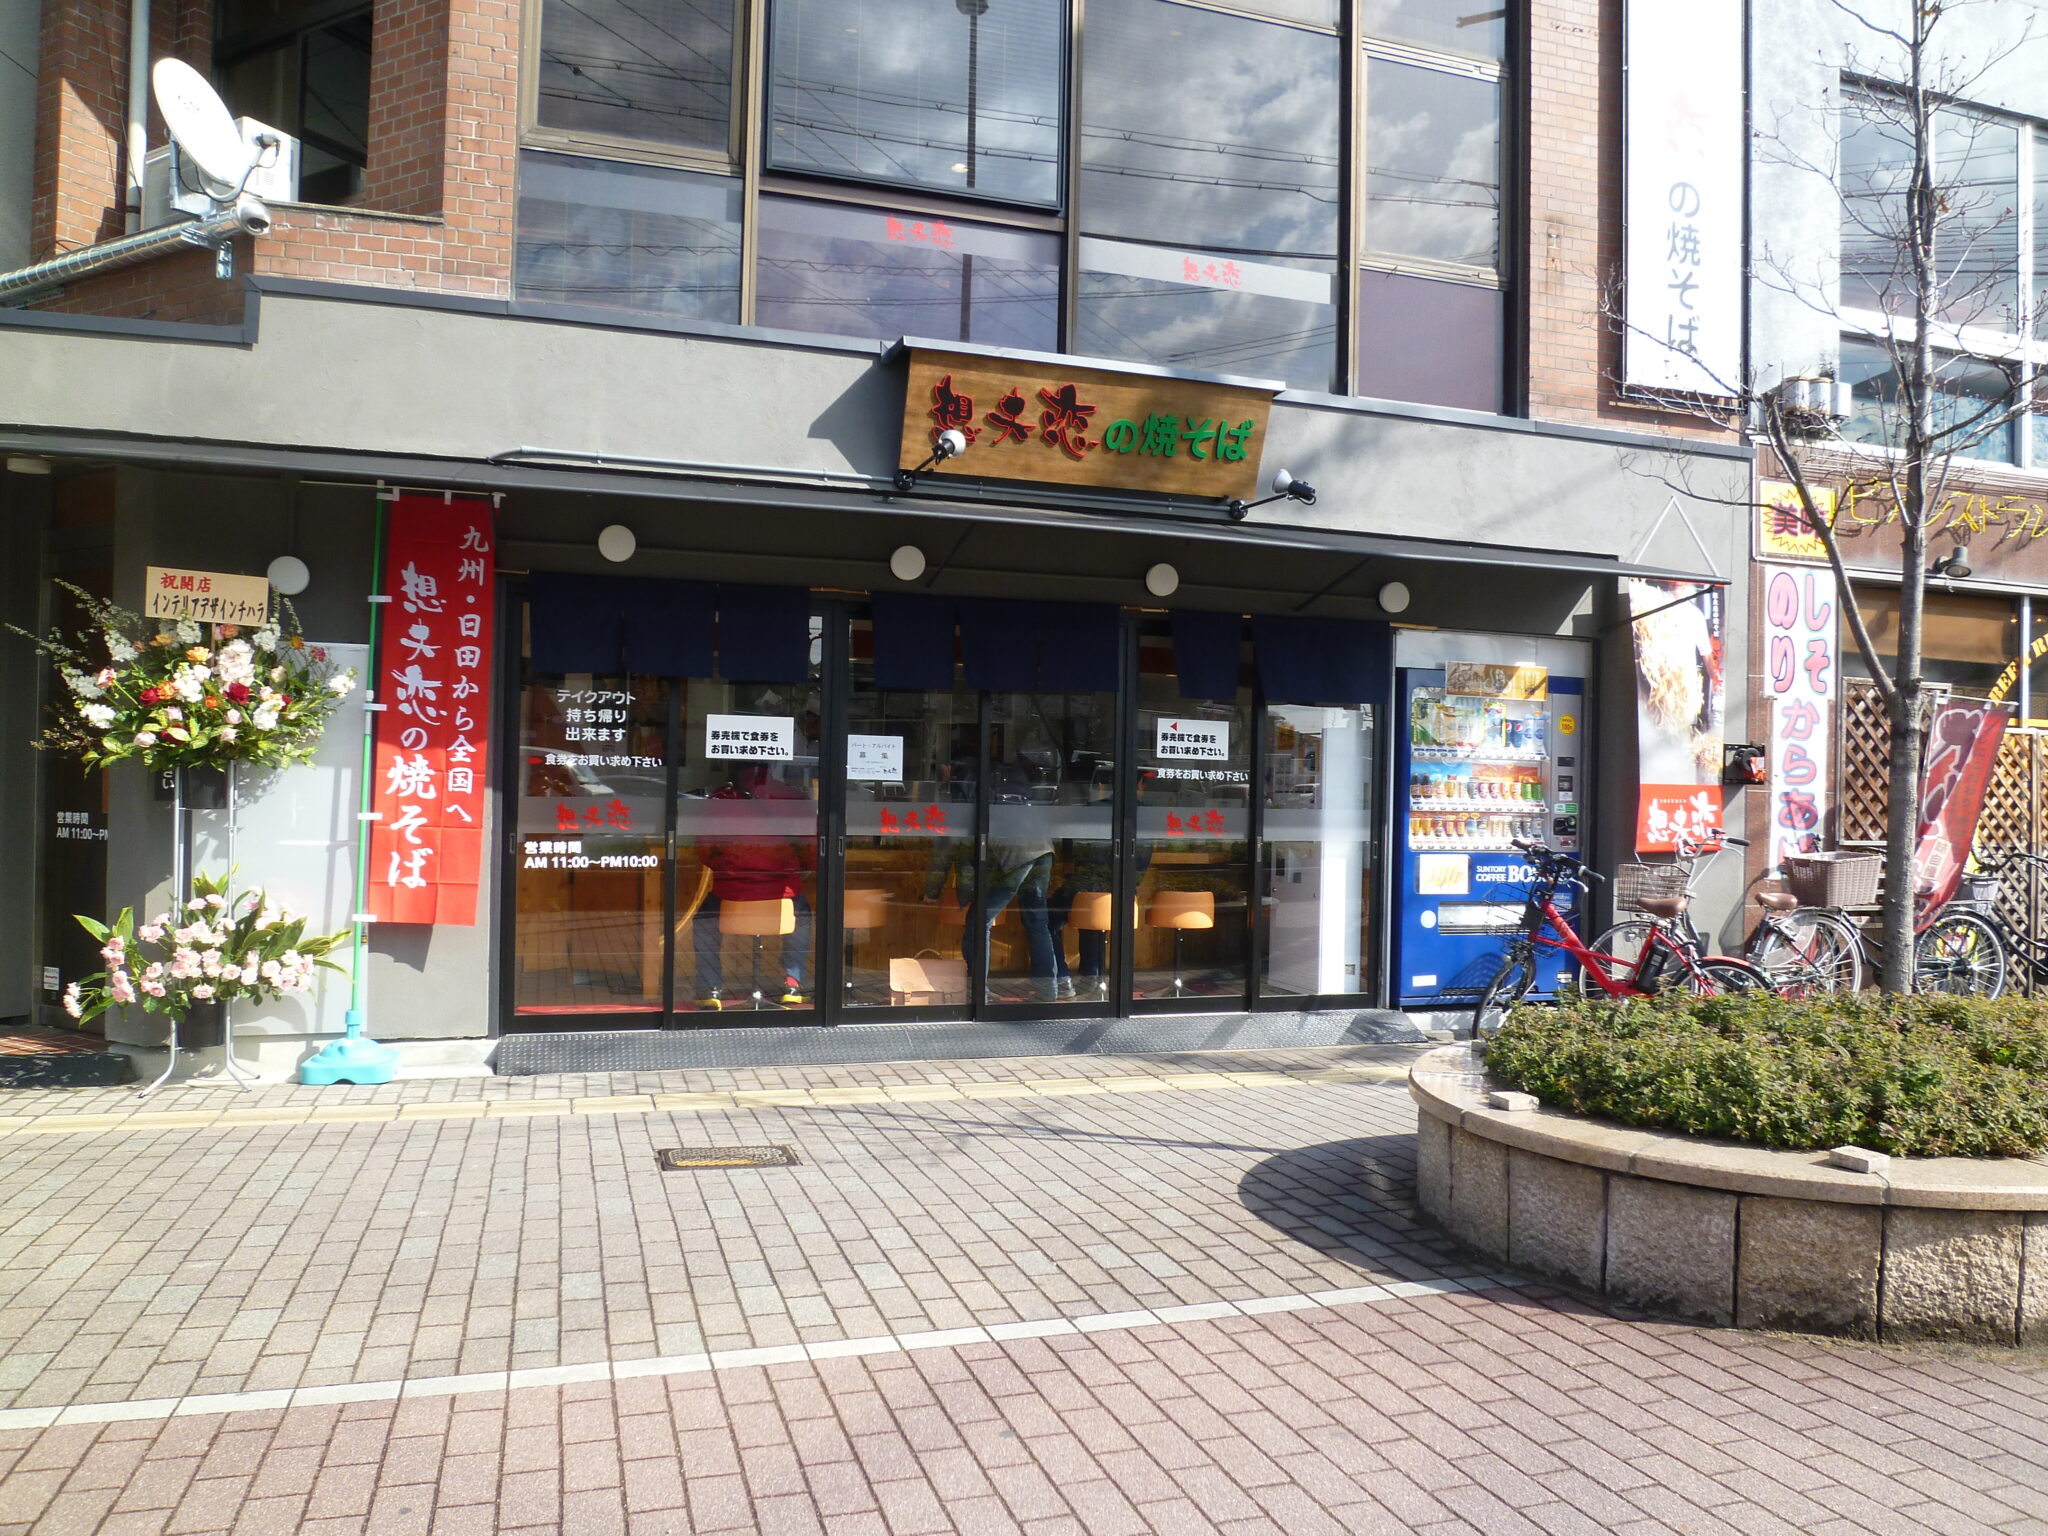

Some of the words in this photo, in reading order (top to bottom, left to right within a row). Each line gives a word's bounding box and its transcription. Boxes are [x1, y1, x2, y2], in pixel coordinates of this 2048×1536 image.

[160, 573, 212, 593] 祝開店
[1767, 572, 1799, 694] のり
[1804, 572, 1831, 694] しそ
[444, 525, 490, 823] 九州・日田から全国へ
[556, 689, 637, 705] テイクアウト
[565, 708, 627, 723] 持ち帰り
[385, 560, 447, 889] 想夫恋の焼そば
[565, 727, 627, 742] 出来ます
[710, 730, 779, 742] 券売機で食券を
[1160, 732, 1217, 744] 券売機で食券を
[710, 744, 789, 756] お買い求め下さい。
[1160, 745, 1225, 757] お買い求め下さい。
[545, 753, 663, 768] 食券をお買い求め下さい
[1157, 768, 1249, 781] 食券をお買い求め下さい
[56, 811, 89, 825] 営業時間
[56, 828, 69, 839] AM
[524, 841, 582, 854] 営業時間
[524, 857, 548, 868] AM
[1476, 865, 1507, 873] SUNTORY
[1475, 874, 1507, 882] COFFEE
[1507, 865, 1549, 883] BO
